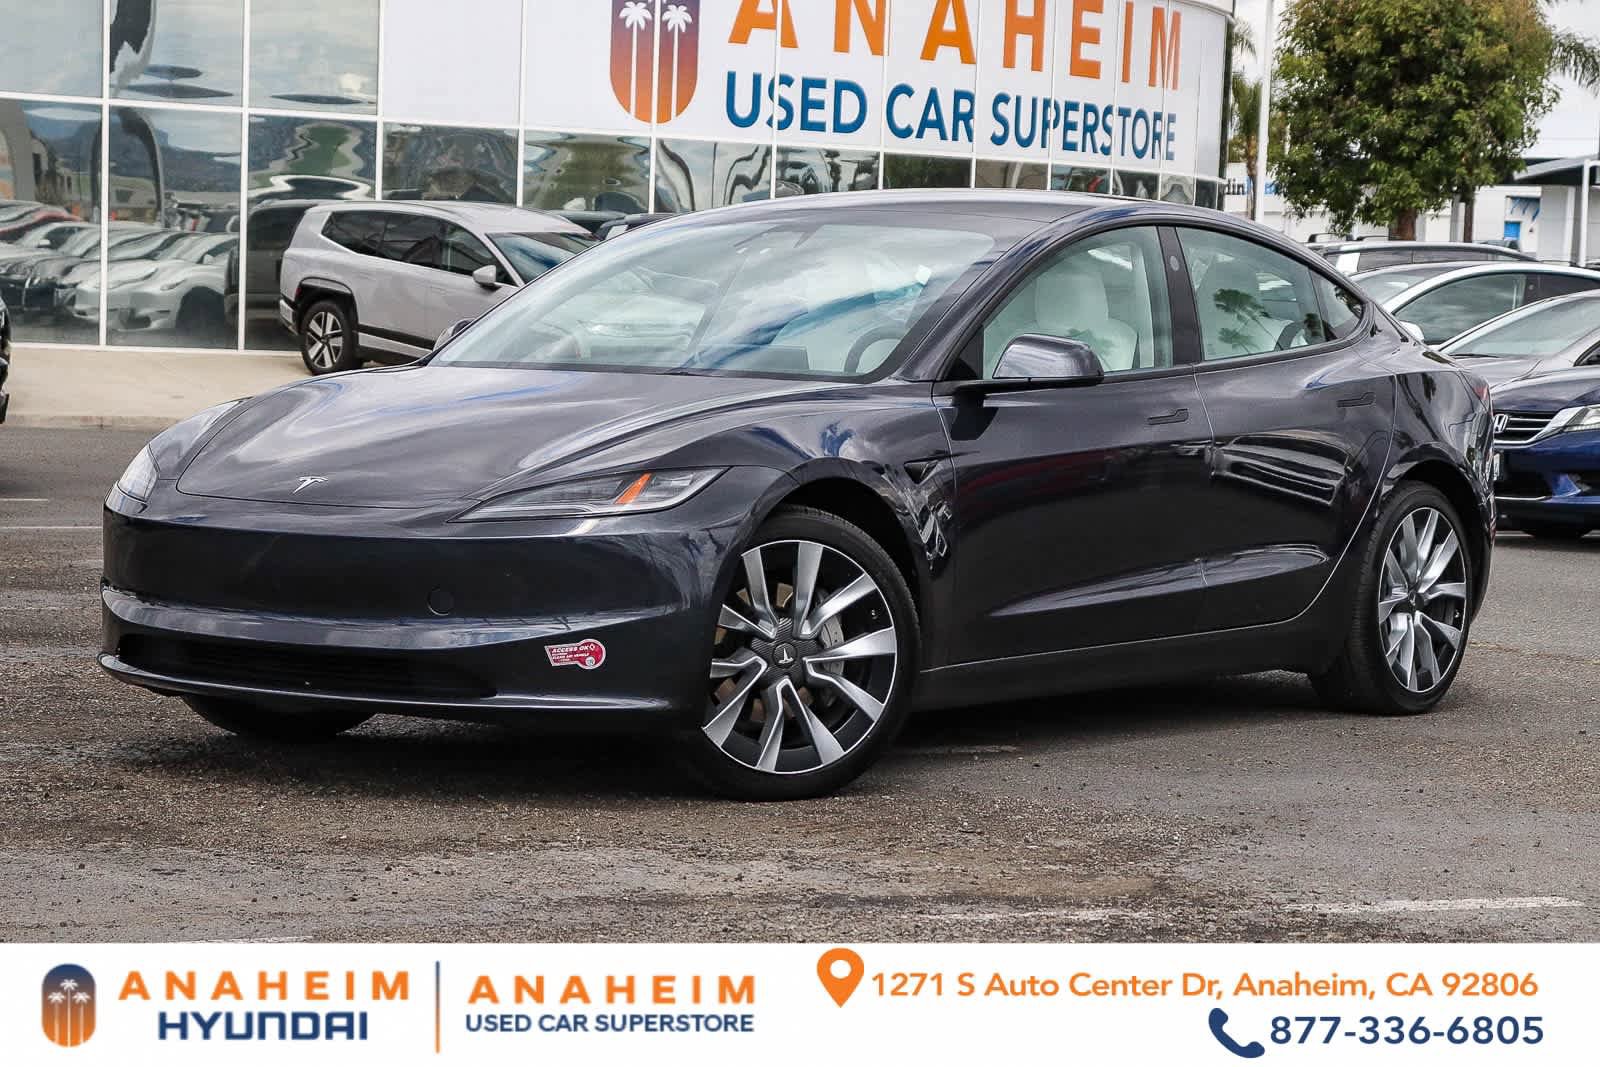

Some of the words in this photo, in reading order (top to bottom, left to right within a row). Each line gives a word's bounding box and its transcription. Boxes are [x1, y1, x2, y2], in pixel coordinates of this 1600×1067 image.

[728, 0, 1182, 90] ANAHEIM
[726, 71, 868, 135] USED
[886, 82, 975, 142] CAR
[990, 91, 1177, 161] SUPERSTORE
